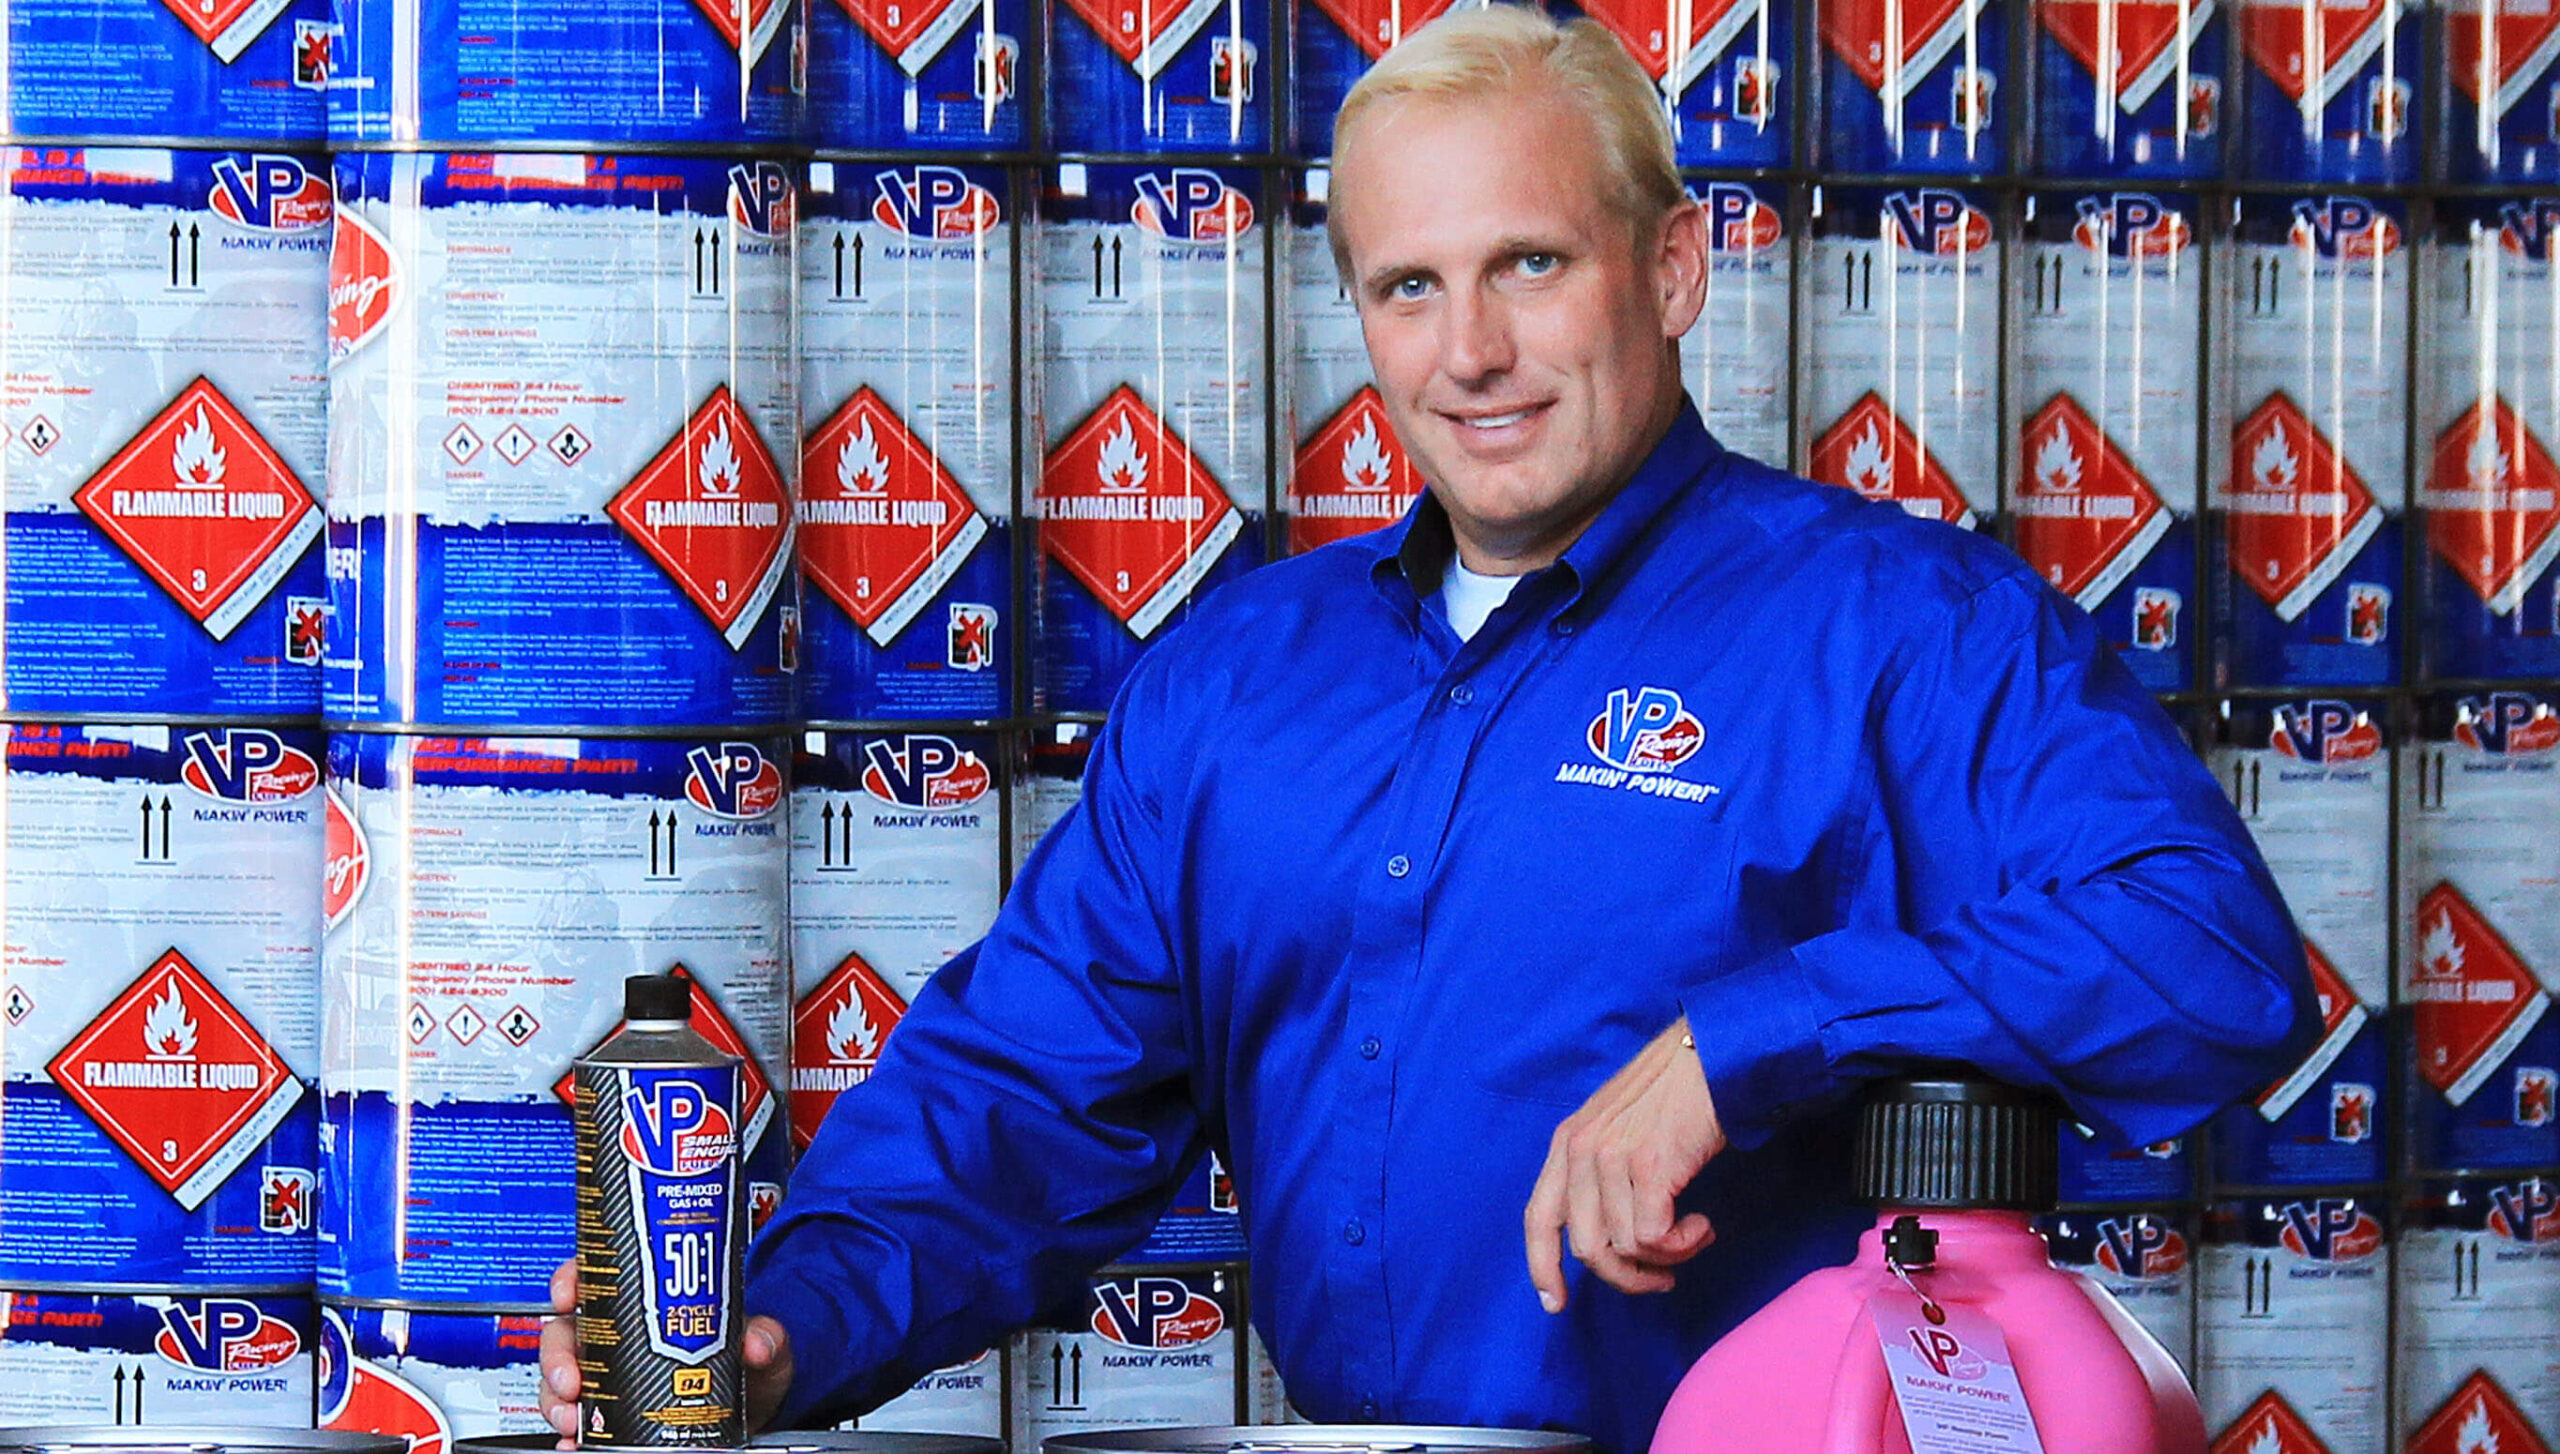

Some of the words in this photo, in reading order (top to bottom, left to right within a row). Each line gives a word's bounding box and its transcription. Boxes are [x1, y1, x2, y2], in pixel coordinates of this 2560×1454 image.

[888, 5, 900, 27] 3
[211, 154, 307, 230] VP
[728, 161, 789, 237] VP
[875, 165, 969, 240] VP
[1133, 168, 1224, 240] VP
[1884, 187, 1966, 257] VP
[548, 381, 582, 391] Hour
[447, 394, 519, 404] Emergency
[524, 394, 568, 404] Phone
[572, 395, 626, 405] Number
[112, 491, 225, 518] FLAMMABLE
[228, 492, 284, 519] LIQUID
[645, 501, 740, 526] FLAMMABLE
[743, 502, 778, 529] LIQUID
[892, 501, 947, 527] LIQUID
[1041, 495, 1148, 520] FLAMMABLE
[1150, 496, 1205, 522] LIQUID
[191, 569, 207, 592] 3
[715, 580, 727, 601] 3
[856, 577, 869, 598] 3
[1116, 571, 1130, 592] 3
[1603, 686, 1682, 768] VP
[2271, 700, 2356, 763] VP
[2456, 692, 2536, 754] VP
[65, 742, 130, 757] PART!
[183, 728, 285, 802] VP
[865, 734, 958, 809] VP
[1555, 763, 1628, 788] MAKIN'
[252, 772, 316, 791] Racing
[686, 742, 762, 818] VP
[193, 808, 250, 822] MAKIN'
[254, 810, 308, 823] POWER!
[873, 815, 928, 828] MAKIN'
[497, 963, 531, 973] Hour
[475, 975, 518, 984] Phone
[521, 976, 576, 985] Number
[84, 1062, 197, 1088] FLAMMABLE
[200, 1063, 259, 1092] LIQUID
[621, 1080, 708, 1176] VP
[162, 1140, 178, 1162] 3
[681, 1134, 737, 1148] SMALL
[679, 1147, 737, 1159] ENGINE
[657, 1184, 723, 1198] PRE-MIXED
[2280, 1199, 2360, 1262] VP
[2097, 1214, 2168, 1277] VP
[664, 1231, 714, 1297] 50:1
[41, 1311, 104, 1327] PART!
[666, 1304, 716, 1318] 2-CYCLE
[1094, 1278, 1189, 1348] VP
[158, 1298, 262, 1371] VP
[666, 1317, 716, 1337] FUEL
[228, 1340, 298, 1360] Racing
[1102, 1353, 1157, 1368] MAKIN'
[1906, 1325, 1963, 1378] VP
[167, 1378, 226, 1392] MAKIN'
[229, 1379, 288, 1392] POWER!
[680, 1376, 706, 1392] 94
[1905, 1374, 1955, 1393] MAKIN'
